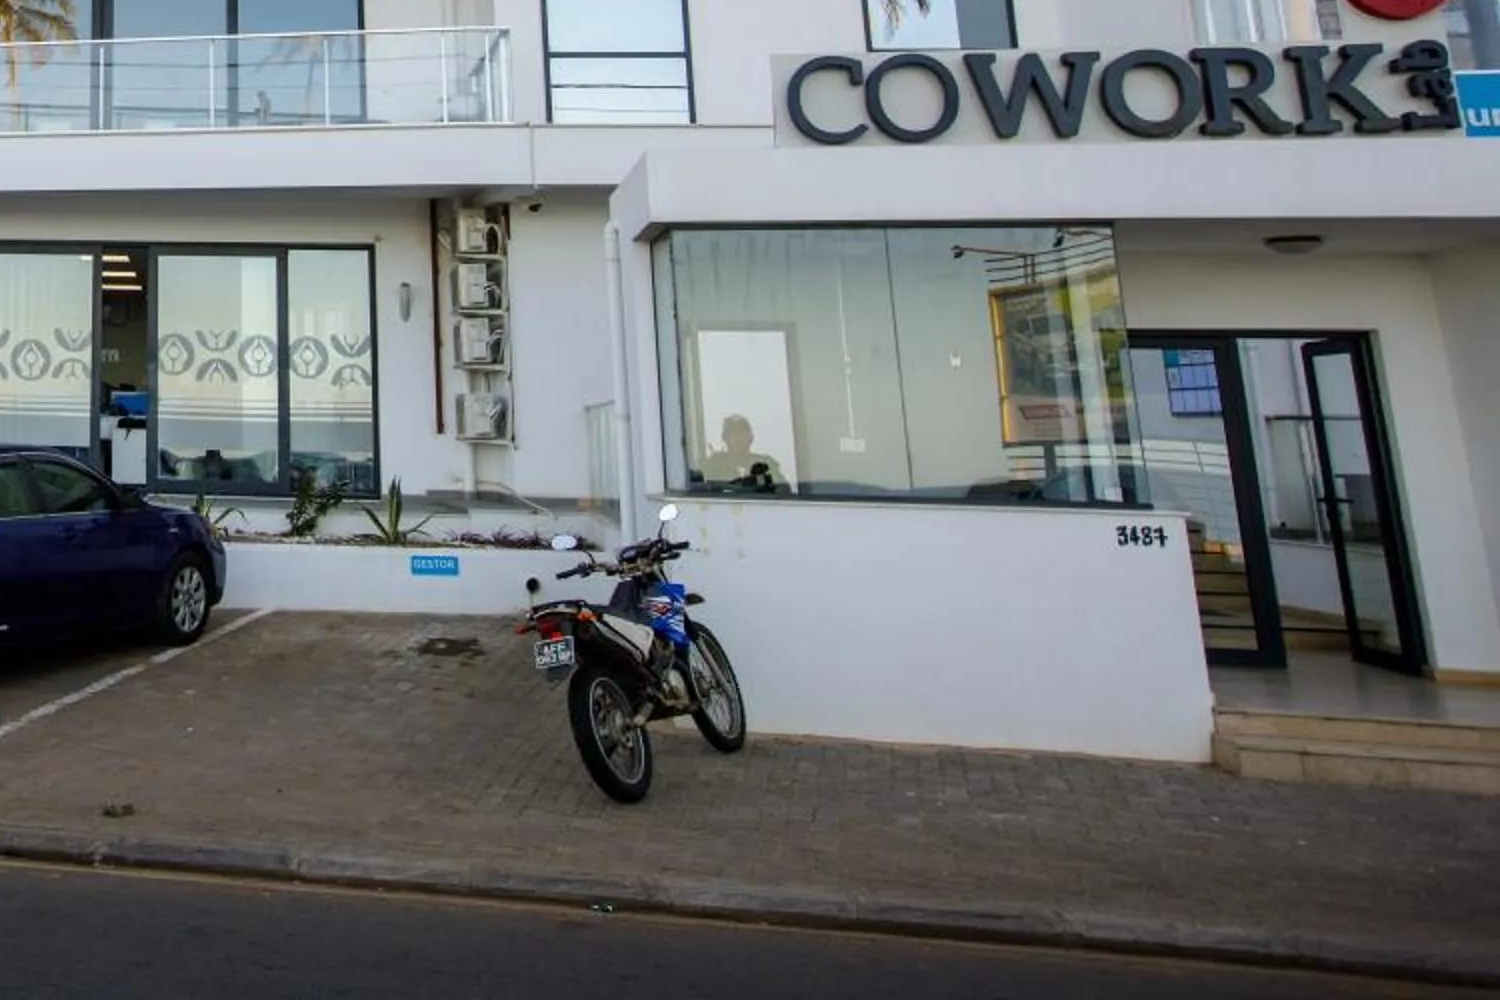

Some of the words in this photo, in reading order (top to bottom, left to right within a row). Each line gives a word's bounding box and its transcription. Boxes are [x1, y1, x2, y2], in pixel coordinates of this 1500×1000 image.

[786, 44, 1402, 144] COWORK
[1116, 524, 1168, 547] 3487
[413, 559, 455, 569] GESTOR
